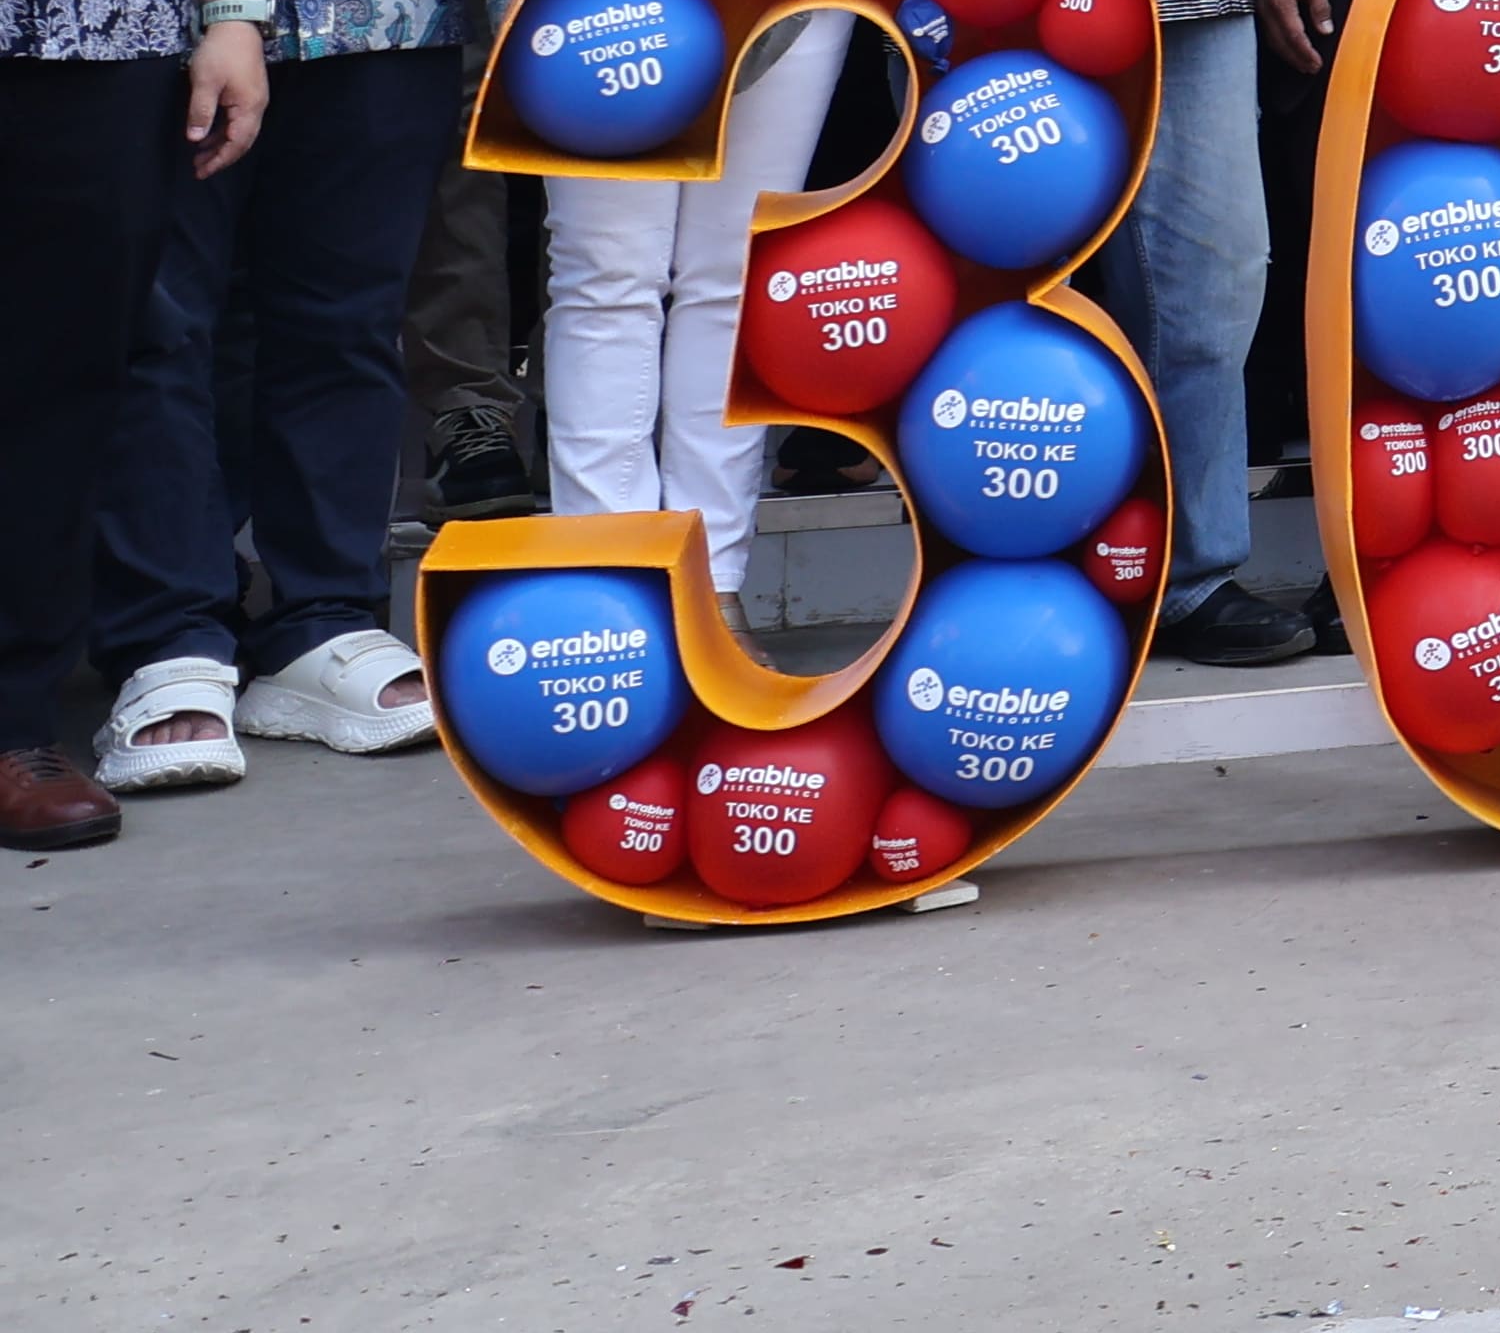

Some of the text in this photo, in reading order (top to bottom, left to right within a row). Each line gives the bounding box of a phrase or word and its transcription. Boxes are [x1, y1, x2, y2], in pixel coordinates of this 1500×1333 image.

[565, 0, 663, 37] erablue
[579, 33, 669, 67] TOKO KE
[597, 56, 663, 97] 300
[951, 68, 1049, 114] erablue
[968, 93, 1062, 139] TOKO KE
[991, 116, 1062, 164] 300
[970, 396, 1086, 423] erablue
[973, 439, 1077, 462] TOKO KE
[981, 466, 1059, 500] 300
